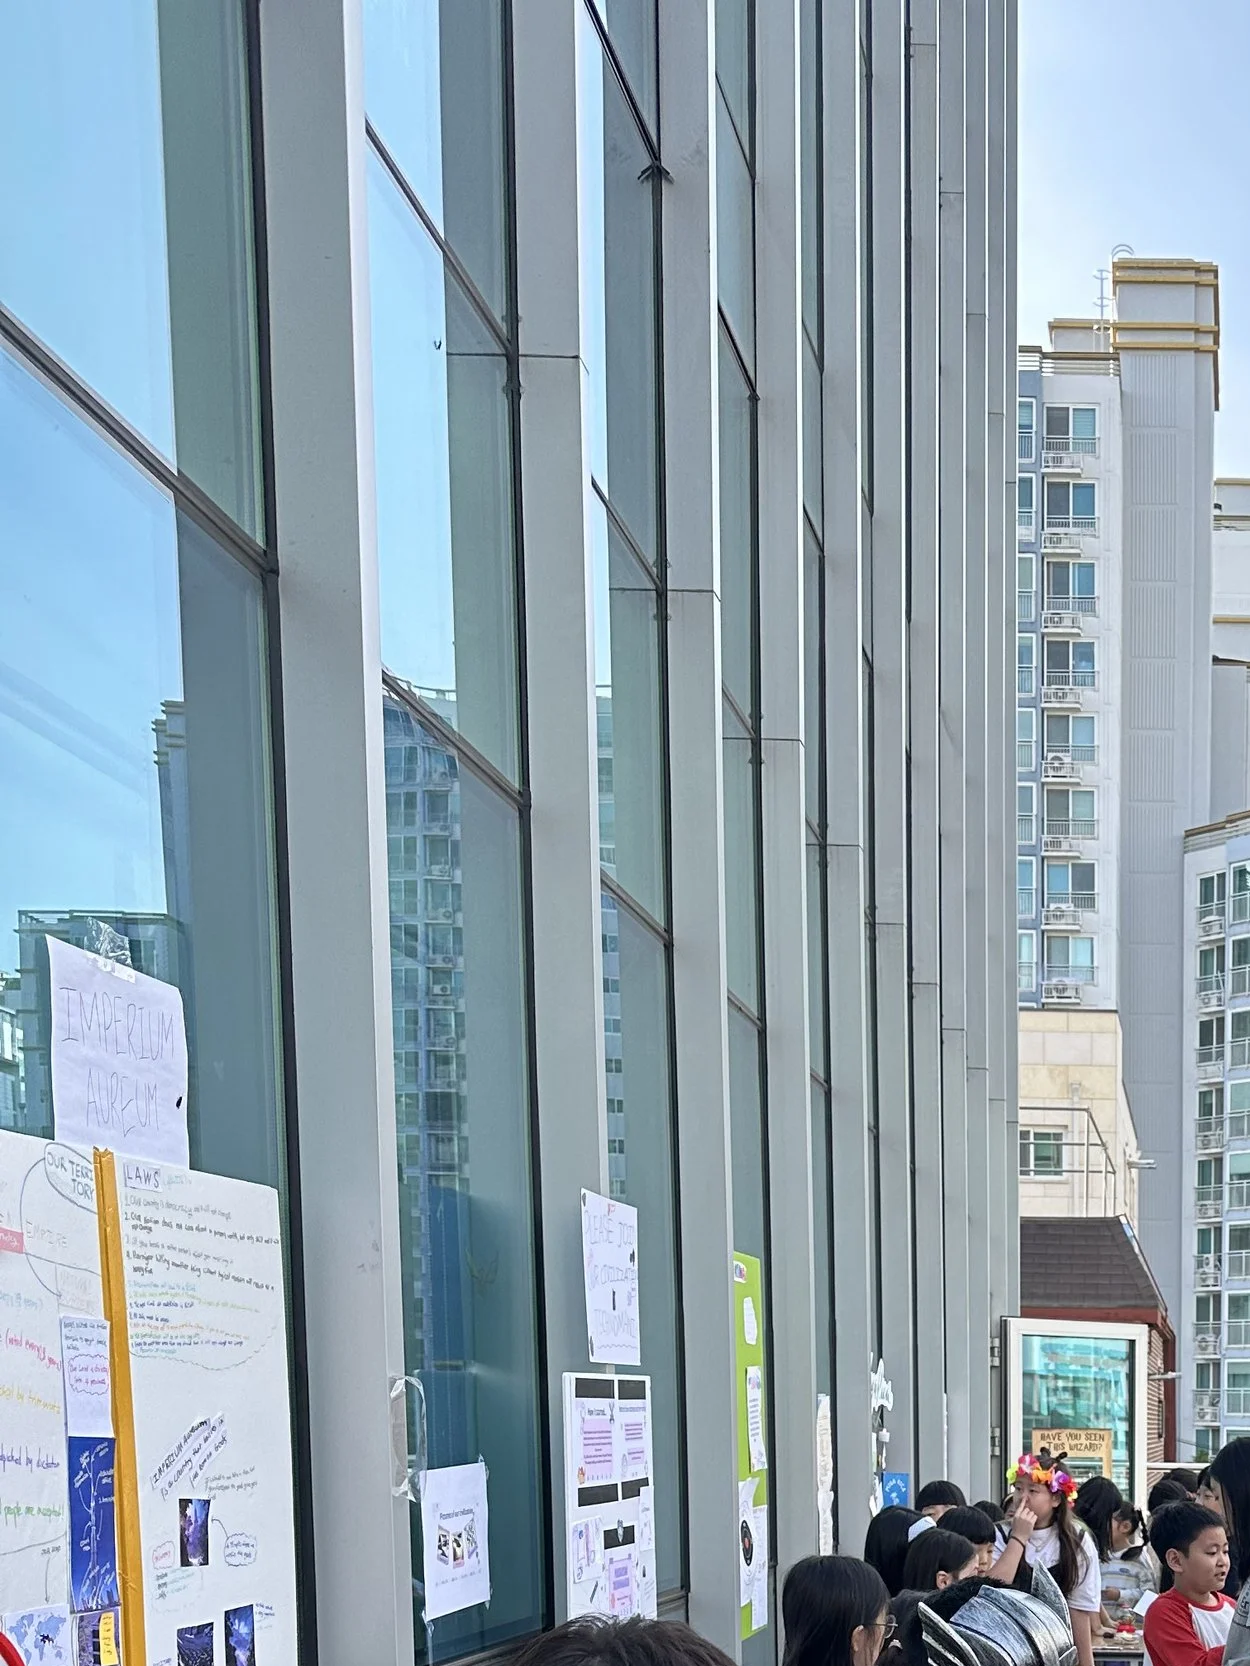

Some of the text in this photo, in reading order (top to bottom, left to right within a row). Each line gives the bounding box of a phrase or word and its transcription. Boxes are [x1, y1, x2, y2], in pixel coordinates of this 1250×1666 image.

[59, 987, 174, 1061] IMPERIUM
[86, 1068, 160, 1138] AUREUM
[47, 1152, 67, 1172] OUR
[126, 1165, 160, 1189] LAWS
[71, 1178, 94, 1201] TORY
[1041, 1432, 1105, 1442] HAVE YOU SEEN
[1046, 1441, 1103, 1452] THIS WIZARD?
[153, 1442, 183, 1483] IMPERIUM
